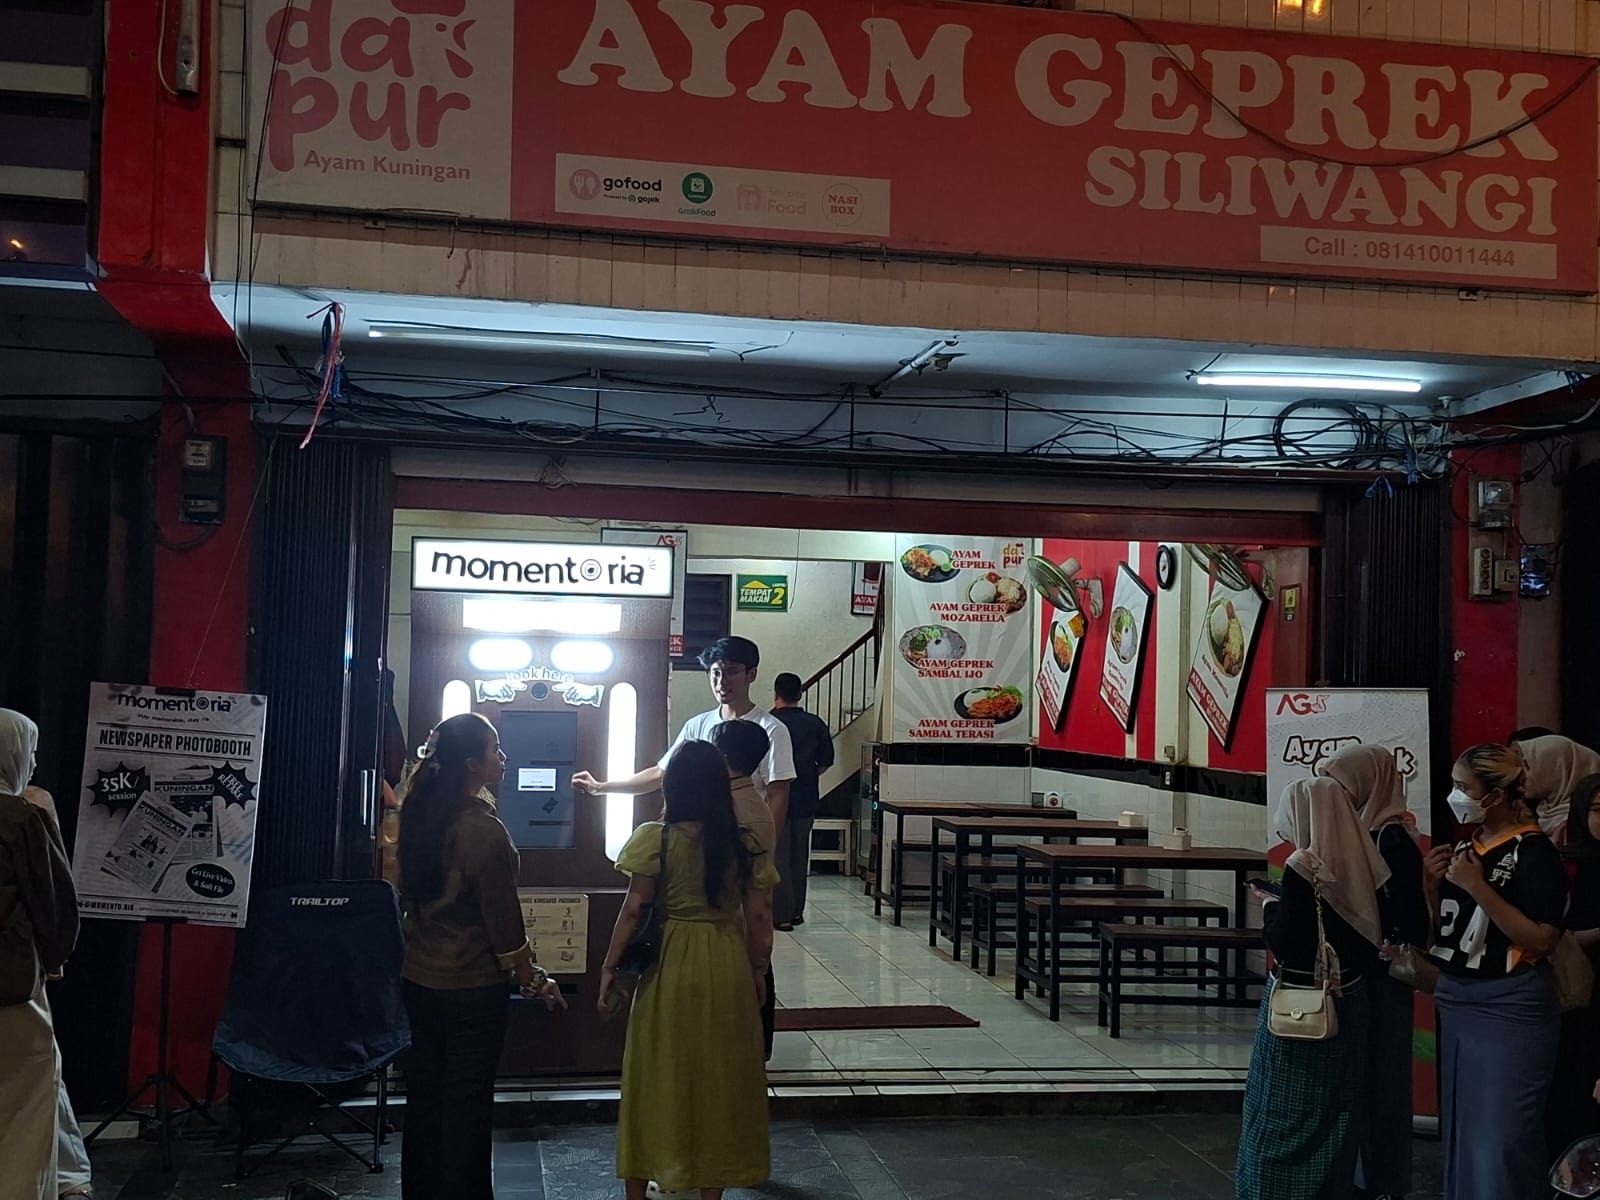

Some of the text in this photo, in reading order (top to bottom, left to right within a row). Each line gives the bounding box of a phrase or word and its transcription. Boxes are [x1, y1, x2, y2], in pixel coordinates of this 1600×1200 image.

[557, 0, 1558, 161] AYAM GEPREK
[268, 68, 471, 172] pur
[304, 149, 470, 182] Ayam Kuningan
[603, 177, 662, 191] gofood
[1084, 145, 1556, 236] SILIWANGI
[637, 196, 660, 204] gojek
[829, 194, 858, 204] NASI
[678, 208, 716, 217] GrabFood
[768, 200, 806, 215] Food
[830, 205, 856, 215] BOX
[1304, 236, 1346, 258] Call
[1364, 239, 1515, 267] 081410011444
[952, 550, 981, 559] AYAM
[952, 561, 996, 569] GEPREK
[1003, 556, 1025, 569] pur
[739, 587, 785, 605] MAKAN 2
[740, 588, 773, 596] TEMPAT
[929, 604, 1006, 612] AYAM GEPREK
[940, 614, 1005, 622] MOZARELLA
[918, 660, 994, 669] AYAM GEPREK
[506, 666, 574, 683] look here
[918, 670, 983, 679] SAMBAL IJO
[1190, 671, 1207, 697] AYAM
[919, 720, 995, 728] AYAM GEPREK
[909, 730, 994, 739] SAMBAL TERASI
[99, 729, 251, 757] NEWSPAPER PHOTOBOOTH
[217, 773, 245, 801] RETAKE
[225, 773, 245, 791] FREE
[108, 791, 137, 801] session
[137, 804, 185, 837] KUNINGAN
[289, 897, 350, 906] TRAILTOP
[1429, 899, 1489, 970] 24
[567, 938, 572, 946] 6
